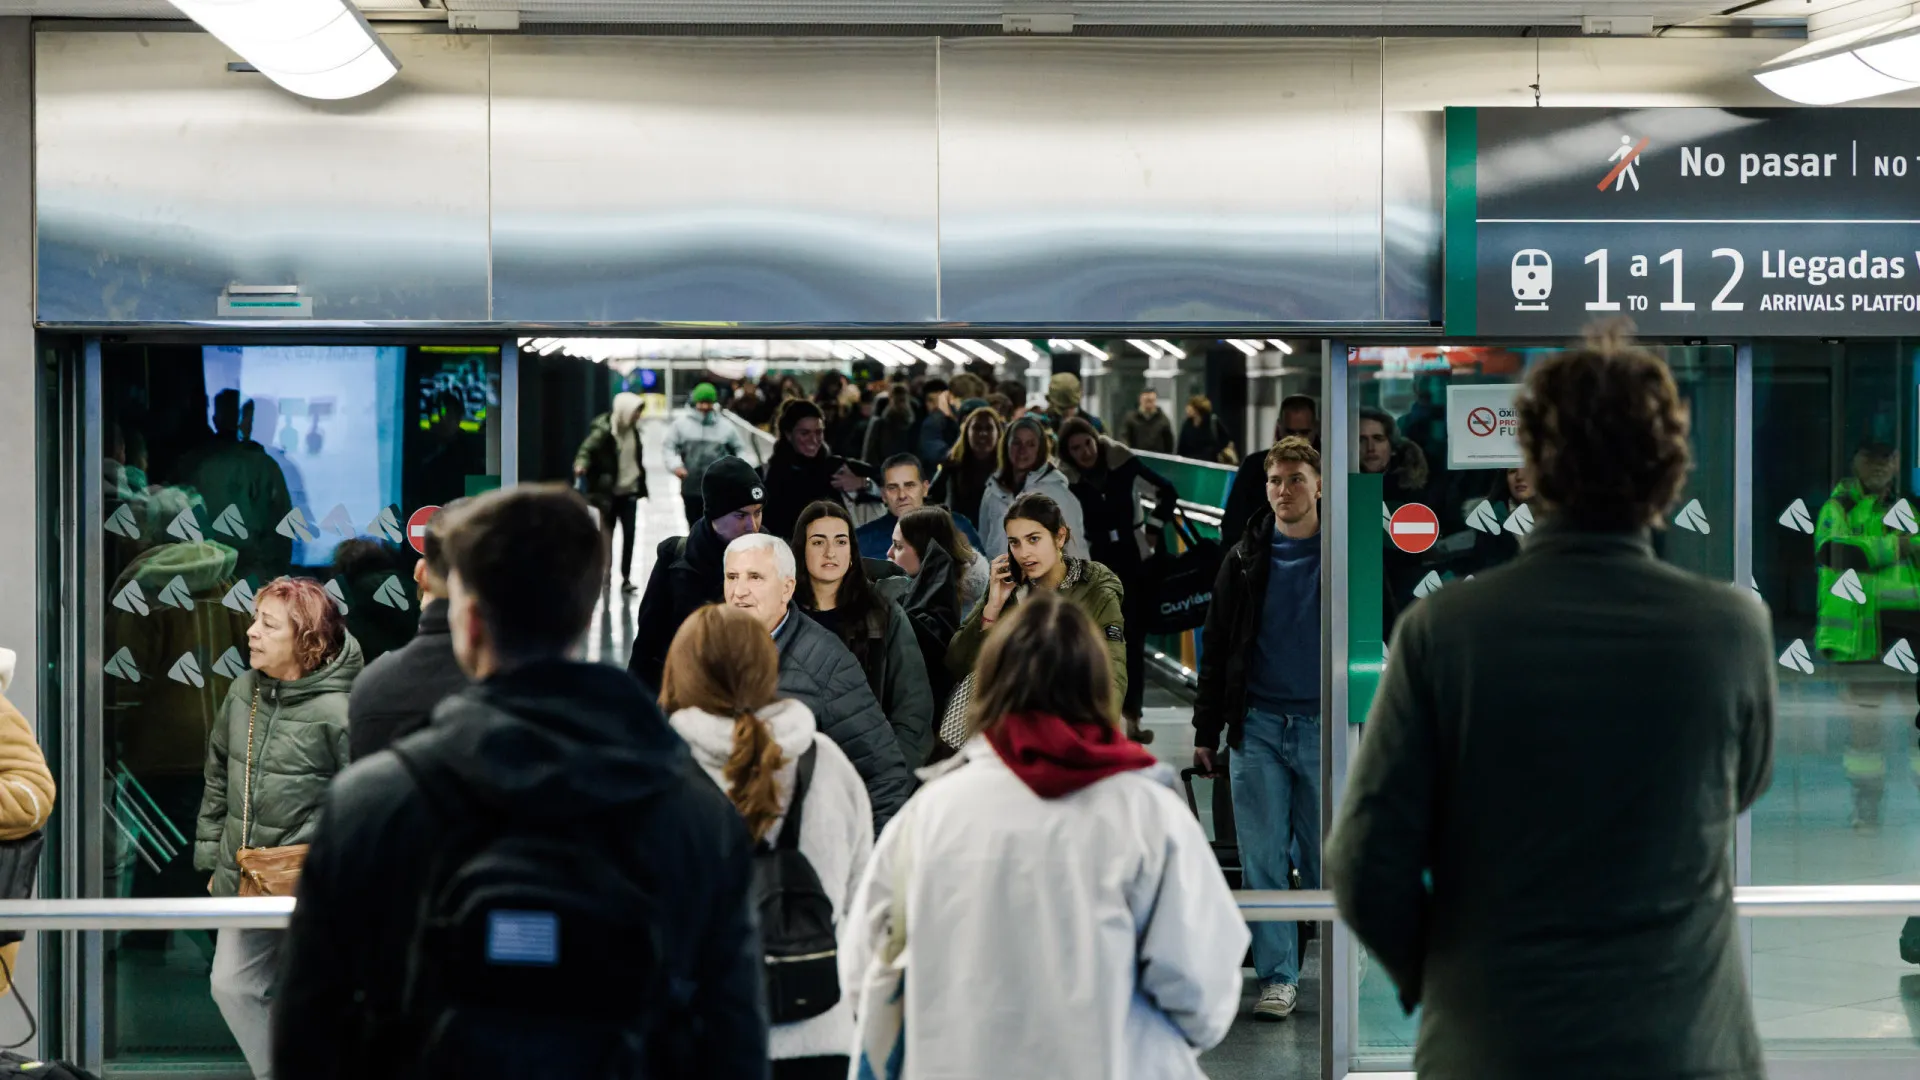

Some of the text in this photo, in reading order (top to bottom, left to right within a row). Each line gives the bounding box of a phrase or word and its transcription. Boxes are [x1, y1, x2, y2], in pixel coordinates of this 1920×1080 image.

[1681, 146, 1837, 184] No pasar
[1874, 156, 1907, 177] NO
[1762, 249, 1906, 286] Llegadas
[1584, 247, 1745, 311] 1 a 12
[1627, 295, 1649, 311] TO
[1760, 294, 1845, 312] ARRIVALS
[1500, 426, 1518, 437] FU
